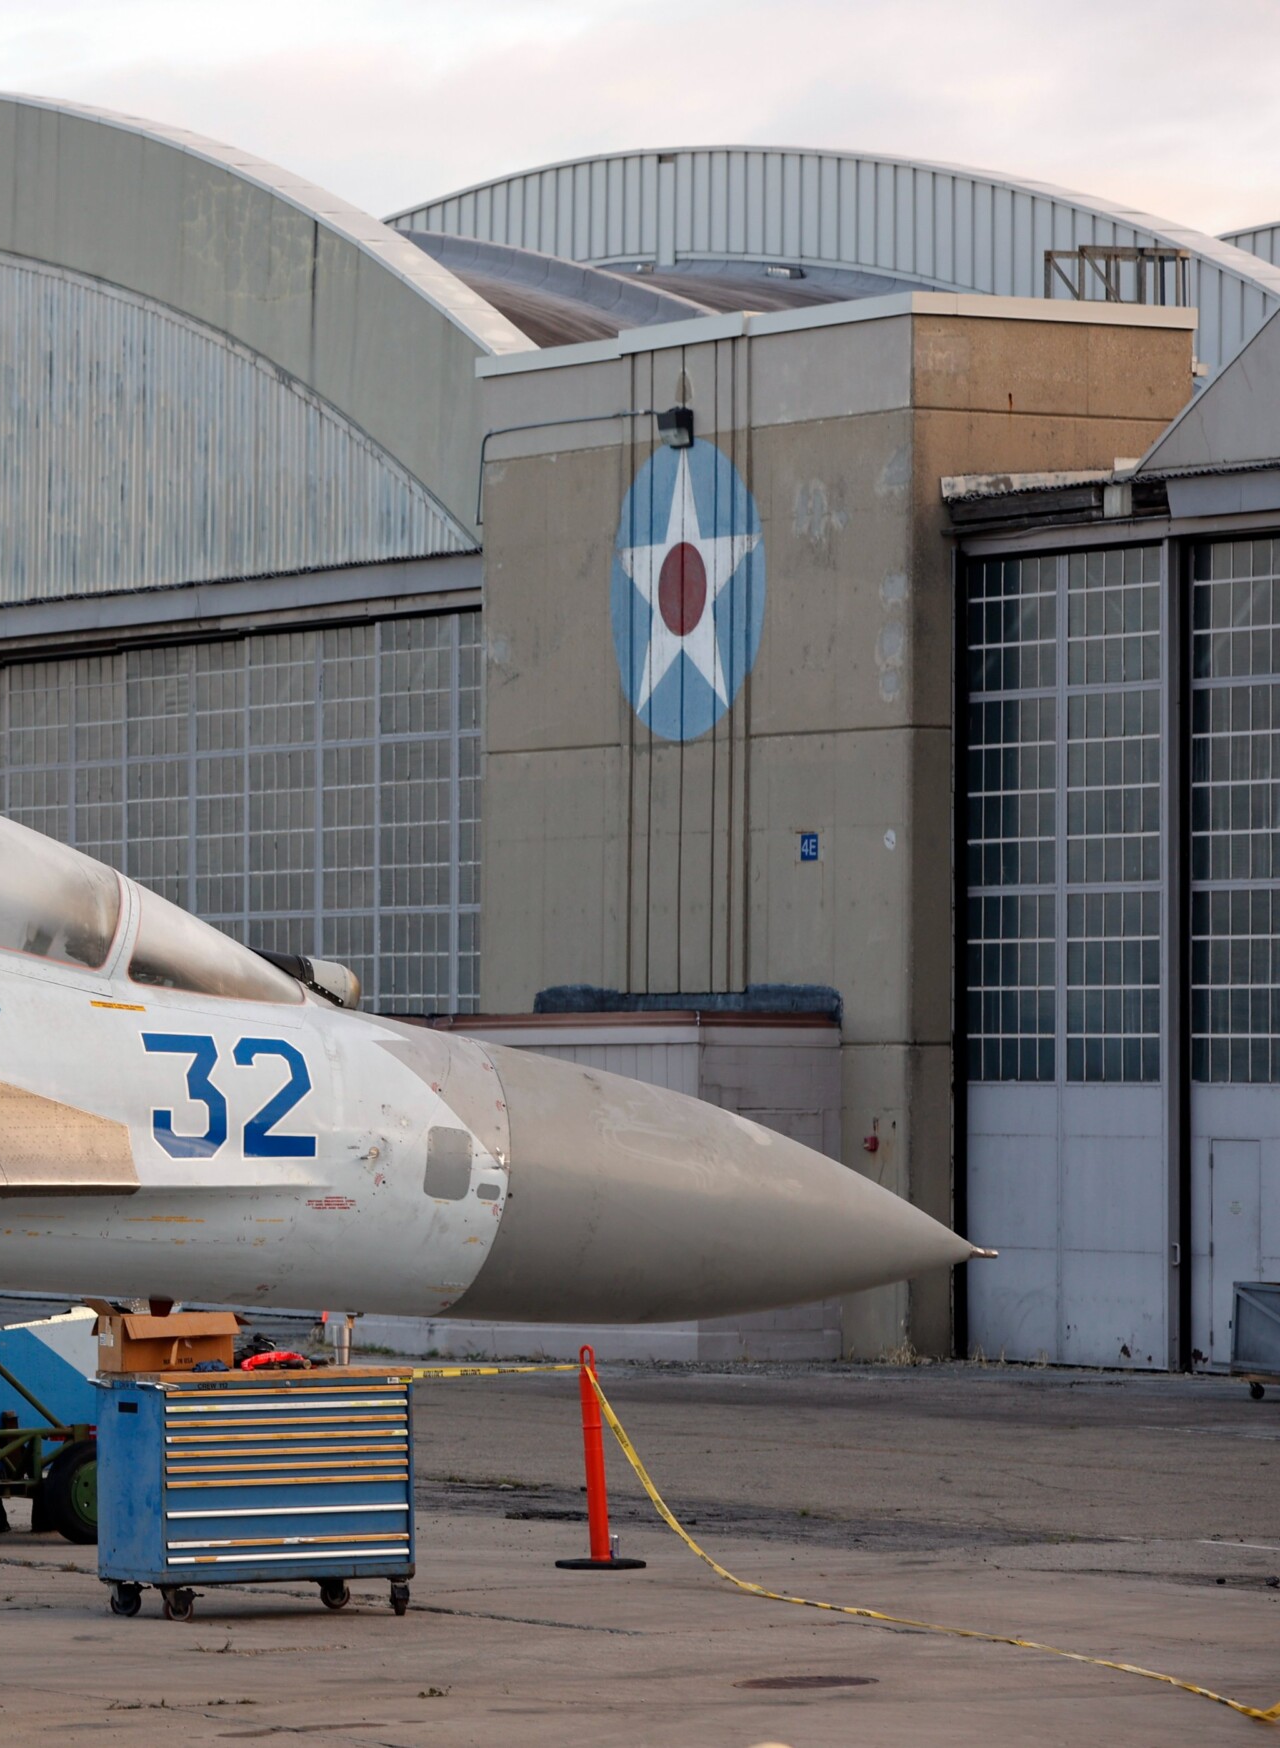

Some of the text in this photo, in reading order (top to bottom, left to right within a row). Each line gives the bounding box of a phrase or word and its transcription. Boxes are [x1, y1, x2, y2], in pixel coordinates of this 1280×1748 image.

[801, 839, 817, 856] 4E
[139, 1030, 319, 1161] 32
[197, 1382, 217, 1390] CREW
